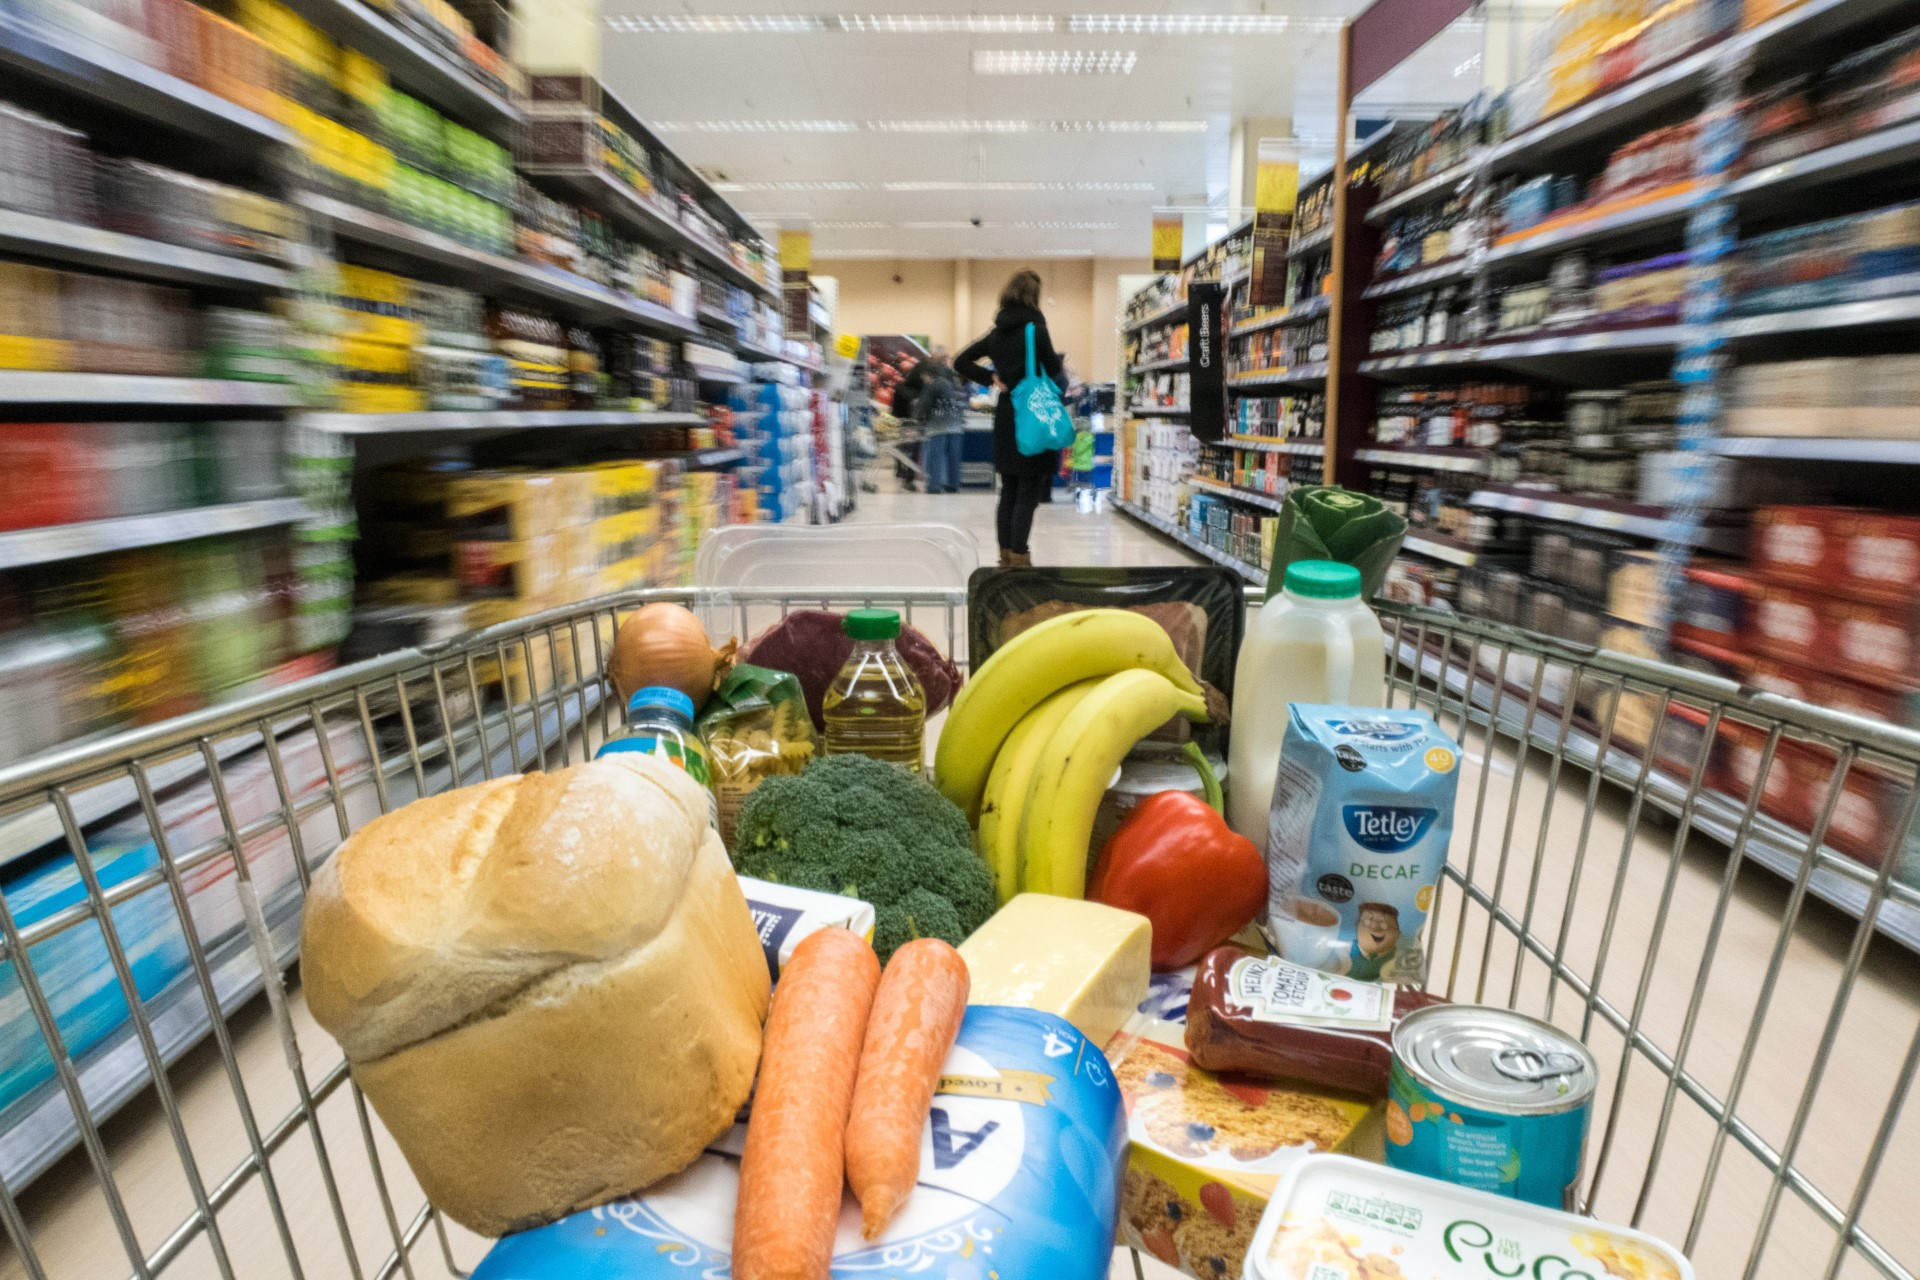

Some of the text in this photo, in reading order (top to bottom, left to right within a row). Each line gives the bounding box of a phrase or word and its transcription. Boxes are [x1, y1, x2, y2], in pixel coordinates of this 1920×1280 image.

[1200, 303, 1211, 368] Craft Beers
[1390, 743, 1414, 753] with
[1354, 811, 1425, 842] Tetley
[1349, 862, 1421, 880] DECAF
[1318, 881, 1354, 898] taste
[1246, 964, 1269, 995] HEINZ
[1271, 967, 1297, 1006] TOMATO
[1290, 971, 1312, 1007] KETCHUP
[1042, 1032, 1073, 1058] 4
[940, 1079, 1003, 1094] Loved
